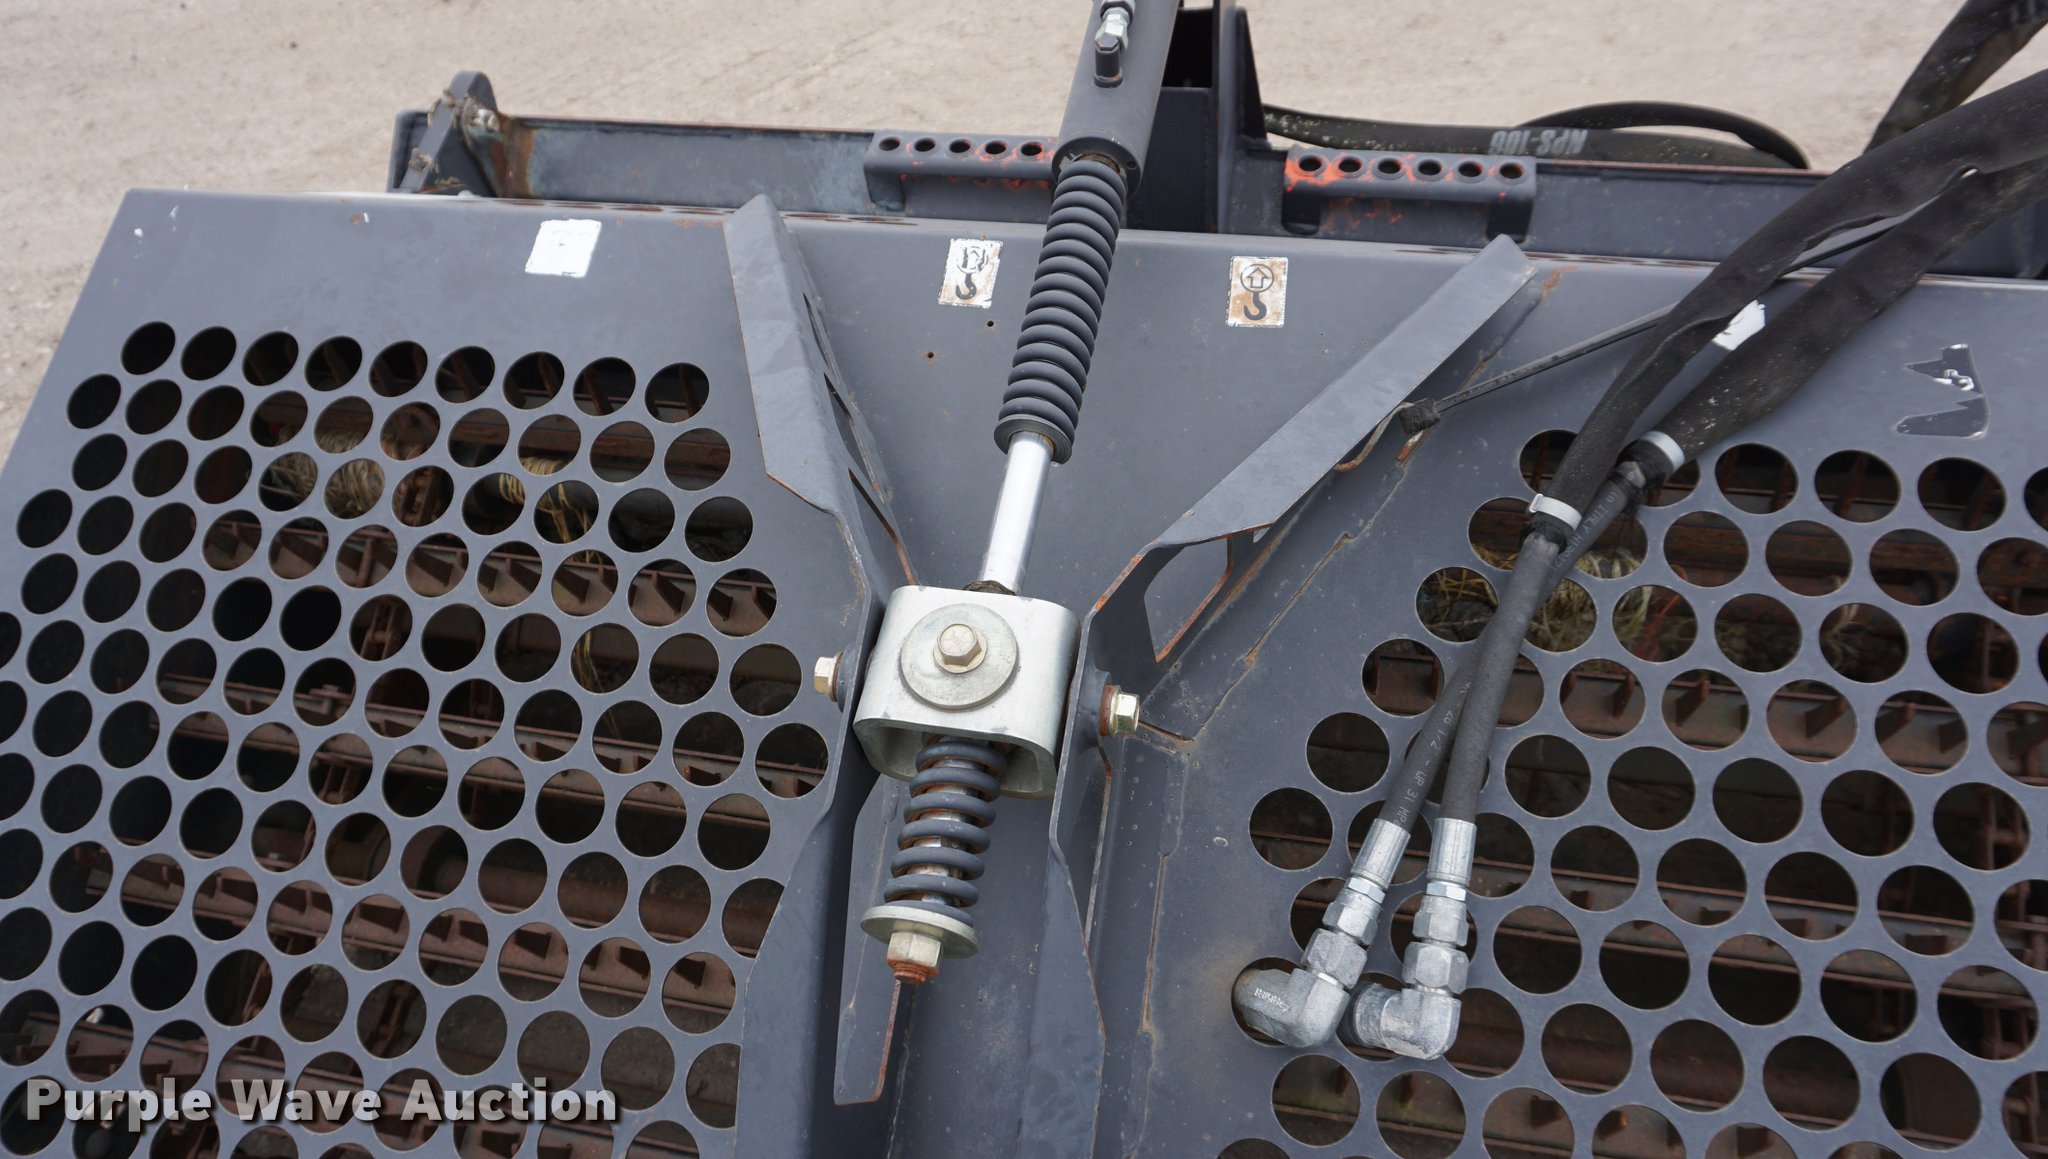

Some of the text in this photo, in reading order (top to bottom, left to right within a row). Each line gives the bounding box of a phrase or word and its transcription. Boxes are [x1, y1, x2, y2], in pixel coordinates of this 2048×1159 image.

[1582, 504, 1609, 534] ITALY
[1414, 770, 1428, 787] WP
[1404, 787, 1419, 803] 31
